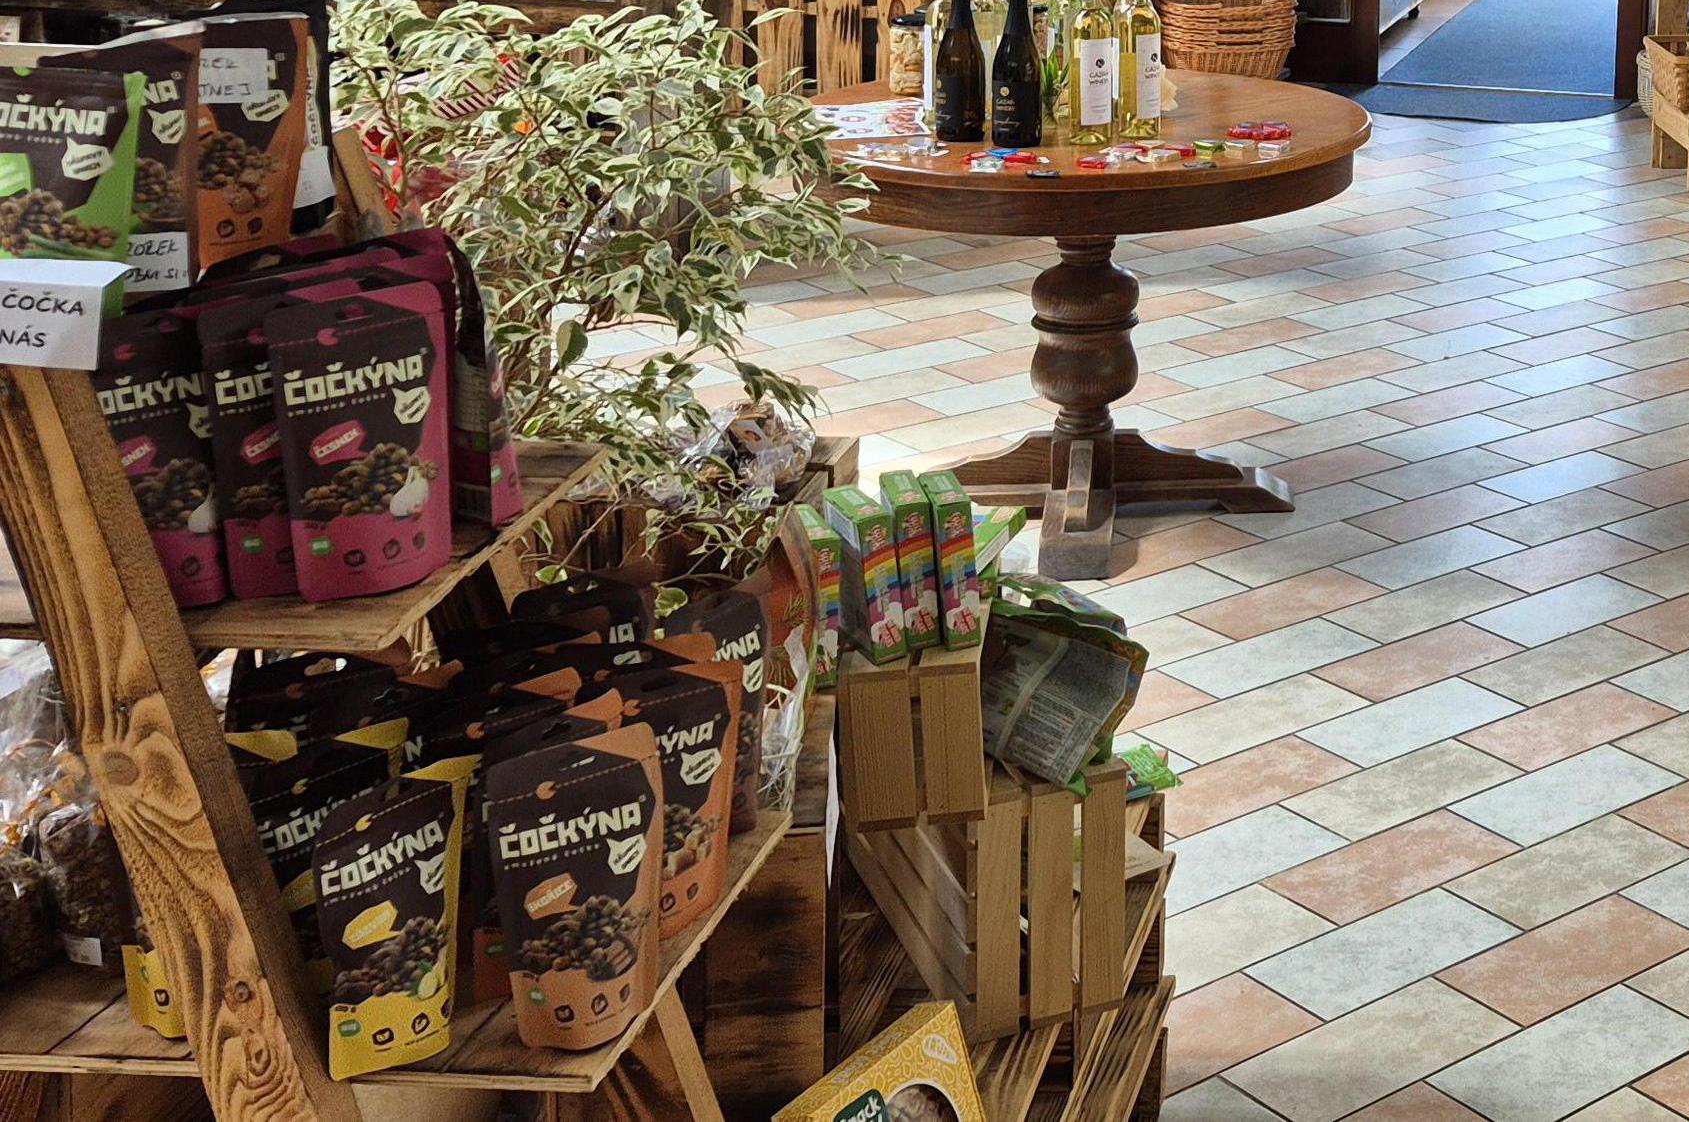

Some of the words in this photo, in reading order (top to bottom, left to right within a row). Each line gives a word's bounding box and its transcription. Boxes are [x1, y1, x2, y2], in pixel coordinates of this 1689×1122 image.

[0, 93, 107, 136] OČKÝNA
[2, 287, 84, 317] ČOČKA
[0, 325, 47, 348] NÁS
[96, 370, 206, 415] OČKÝN
[283, 354, 424, 406] ČOČKÝNA
[498, 801, 642, 860] ČOČKÝNA
[320, 820, 445, 897] ČOČKÝNA
